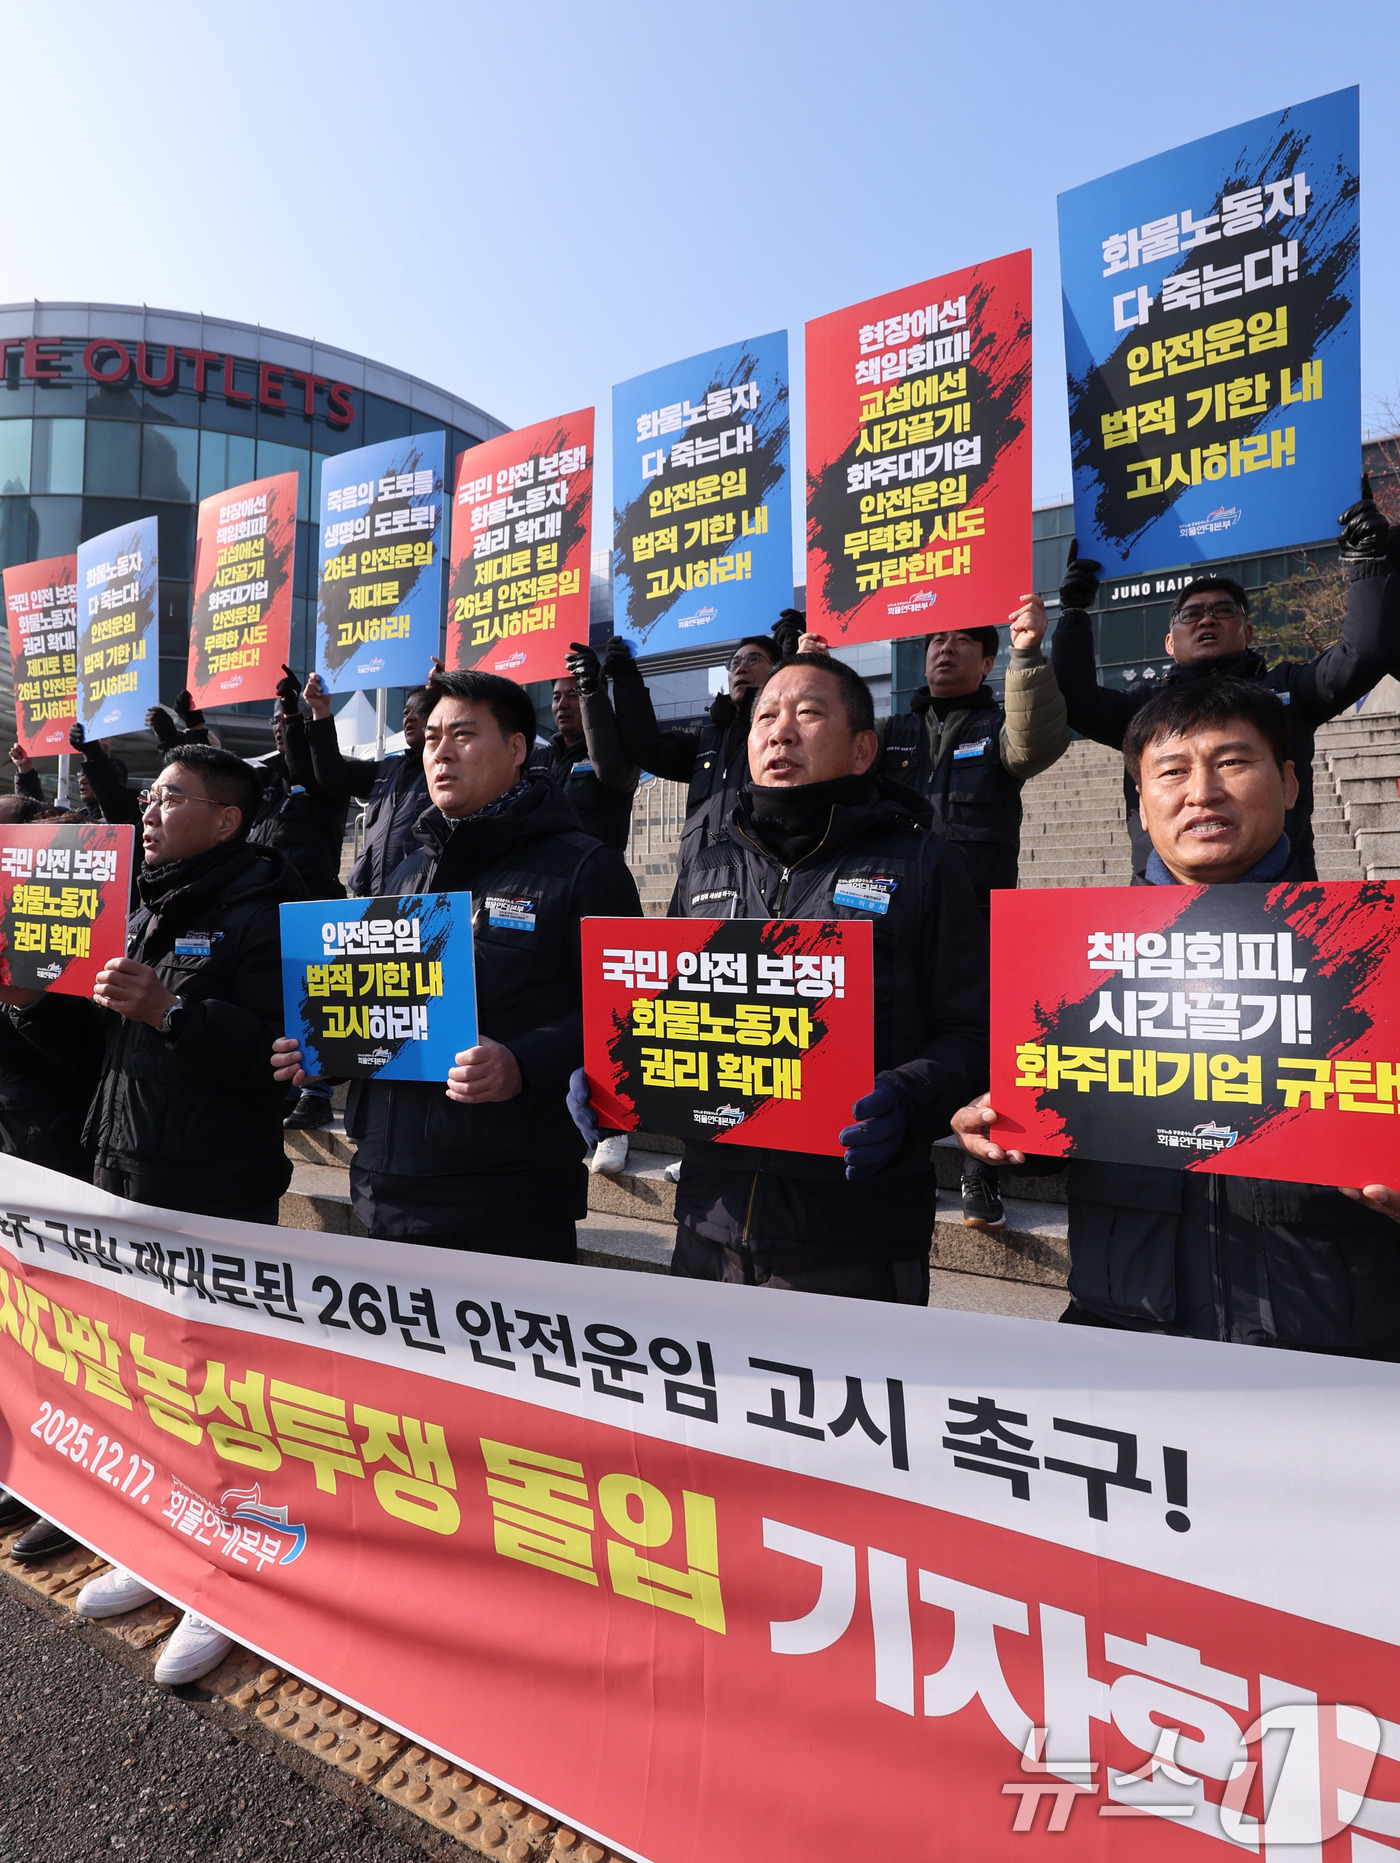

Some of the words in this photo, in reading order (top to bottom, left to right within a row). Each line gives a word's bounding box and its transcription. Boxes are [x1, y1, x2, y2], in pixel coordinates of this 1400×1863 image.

[1101, 172, 1311, 279] 화물노동자
[1114, 286, 1153, 332] 다
[1161, 239, 1299, 315] 죽는다!
[858, 295, 966, 355] 현장에선
[1126, 306, 1289, 387] 안전운임
[855, 330, 970, 386] 책임회피!
[83, 338, 355, 426] OUTLETS
[859, 366, 967, 423] 교섭에선
[1101, 398, 1177, 450] 법적
[1186, 377, 1270, 430] 기한
[1280, 360, 1324, 404] 내
[636, 381, 760, 443] 화물노동자
[856, 401, 970, 457] 시간끌기!
[642, 451, 665, 480] 다
[670, 424, 752, 468] 죽는다!
[847, 435, 982, 494] 화주대기업
[1126, 427, 1296, 500] 고시하라!
[327, 481, 373, 512] 죽음의
[377, 470, 433, 501] 도로를
[458, 476, 493, 506] 국민
[496, 462, 535, 494] 안전
[538, 445, 586, 481] 보장!
[649, 468, 747, 519] 안전운임
[219, 495, 267, 525] 현장에선
[470, 481, 568, 532] 화물노동자
[860, 474, 967, 525] 안전운임
[216, 516, 267, 545] 책임회피!
[324, 515, 370, 549] 생명의
[374, 505, 435, 538] 도로로!
[473, 525, 509, 559] 권리
[514, 511, 562, 544] 확대!
[632, 530, 677, 562] 법적
[683, 514, 735, 549] 기한
[742, 505, 768, 535] 내
[843, 518, 922, 560] 무력화
[929, 507, 985, 542] 시도
[86, 551, 143, 589] 화물노동자
[213, 560, 264, 589] 시간끌기!
[216, 538, 264, 568] 교섭에선
[324, 554, 356, 582] 26년
[361, 541, 433, 575] 안전운임
[474, 550, 531, 587] 제대로
[536, 542, 557, 570] 된
[646, 551, 751, 599] 고시하라!
[856, 545, 971, 592] 규탄한다!
[8, 592, 28, 613] 국민
[30, 587, 54, 608] 안전
[88, 597, 99, 617] 다
[100, 582, 139, 610] 죽는다!
[208, 580, 268, 611] 화주대기업
[348, 581, 399, 610] 제대로
[454, 595, 493, 622] 26년
[497, 568, 580, 611] 안전운임
[1111, 583, 1150, 600] JUNO
[18, 608, 77, 635] 화물노동자
[91, 612, 136, 644] 안전운임
[204, 630, 239, 654] 무력화
[240, 625, 268, 646] 시도
[212, 604, 261, 631] 안전운임
[337, 614, 410, 647] 고시하라!
[471, 604, 556, 646] 고시하라!
[23, 636, 45, 656] 권리
[47, 631, 75, 652] 확대!
[27, 656, 61, 677] 제대로
[63, 653, 75, 673] 된
[84, 651, 104, 675] 법적
[106, 642, 130, 668] 기한
[132, 639, 146, 661] 내
[208, 648, 260, 675] 규탄한다!
[18, 682, 40, 701] 26년
[89, 671, 138, 702] 고시하라!
[1, 848, 33, 877] 국민
[36, 849, 70, 879] 안전
[73, 850, 117, 882] 보장!
[12, 884, 98, 920] 화물노동자
[14, 921, 47, 953] 권리
[50, 924, 91, 958] 확대!
[321, 918, 421, 956] 안전운임
[1087, 930, 1308, 984] 책임회피,
[306, 963, 355, 998] 법적
[358, 962, 410, 997] 기한
[415, 961, 443, 997] 내
[602, 948, 669, 991] 국민
[676, 952, 748, 994] 안전
[756, 953, 845, 999] 보장!
[322, 1005, 429, 1041] 고시하라!
[631, 997, 814, 1050] 화물노동자
[1089, 989, 1312, 1046] 시간끌기!
[640, 1047, 709, 1092] 권리
[717, 1052, 802, 1101] 확대!
[1015, 1041, 1263, 1105] 화주대기업
[1275, 1055, 1400, 1115] 규탄
[1157, 1134, 1225, 1151] 화물연대본부
[129, 1241, 305, 1324] 제대로된
[311, 1274, 446, 1355] 26년
[456, 1298, 719, 1425] 안전운임
[746, 1356, 910, 1472] 고시
[941, 1395, 1191, 1534] 촉구!
[30, 1401, 156, 1505] 2025.12.17.
[129, 1332, 461, 1536] 농성투쟁
[479, 1437, 727, 1636] 돌입
[162, 1490, 281, 1572] 화물연대본부
